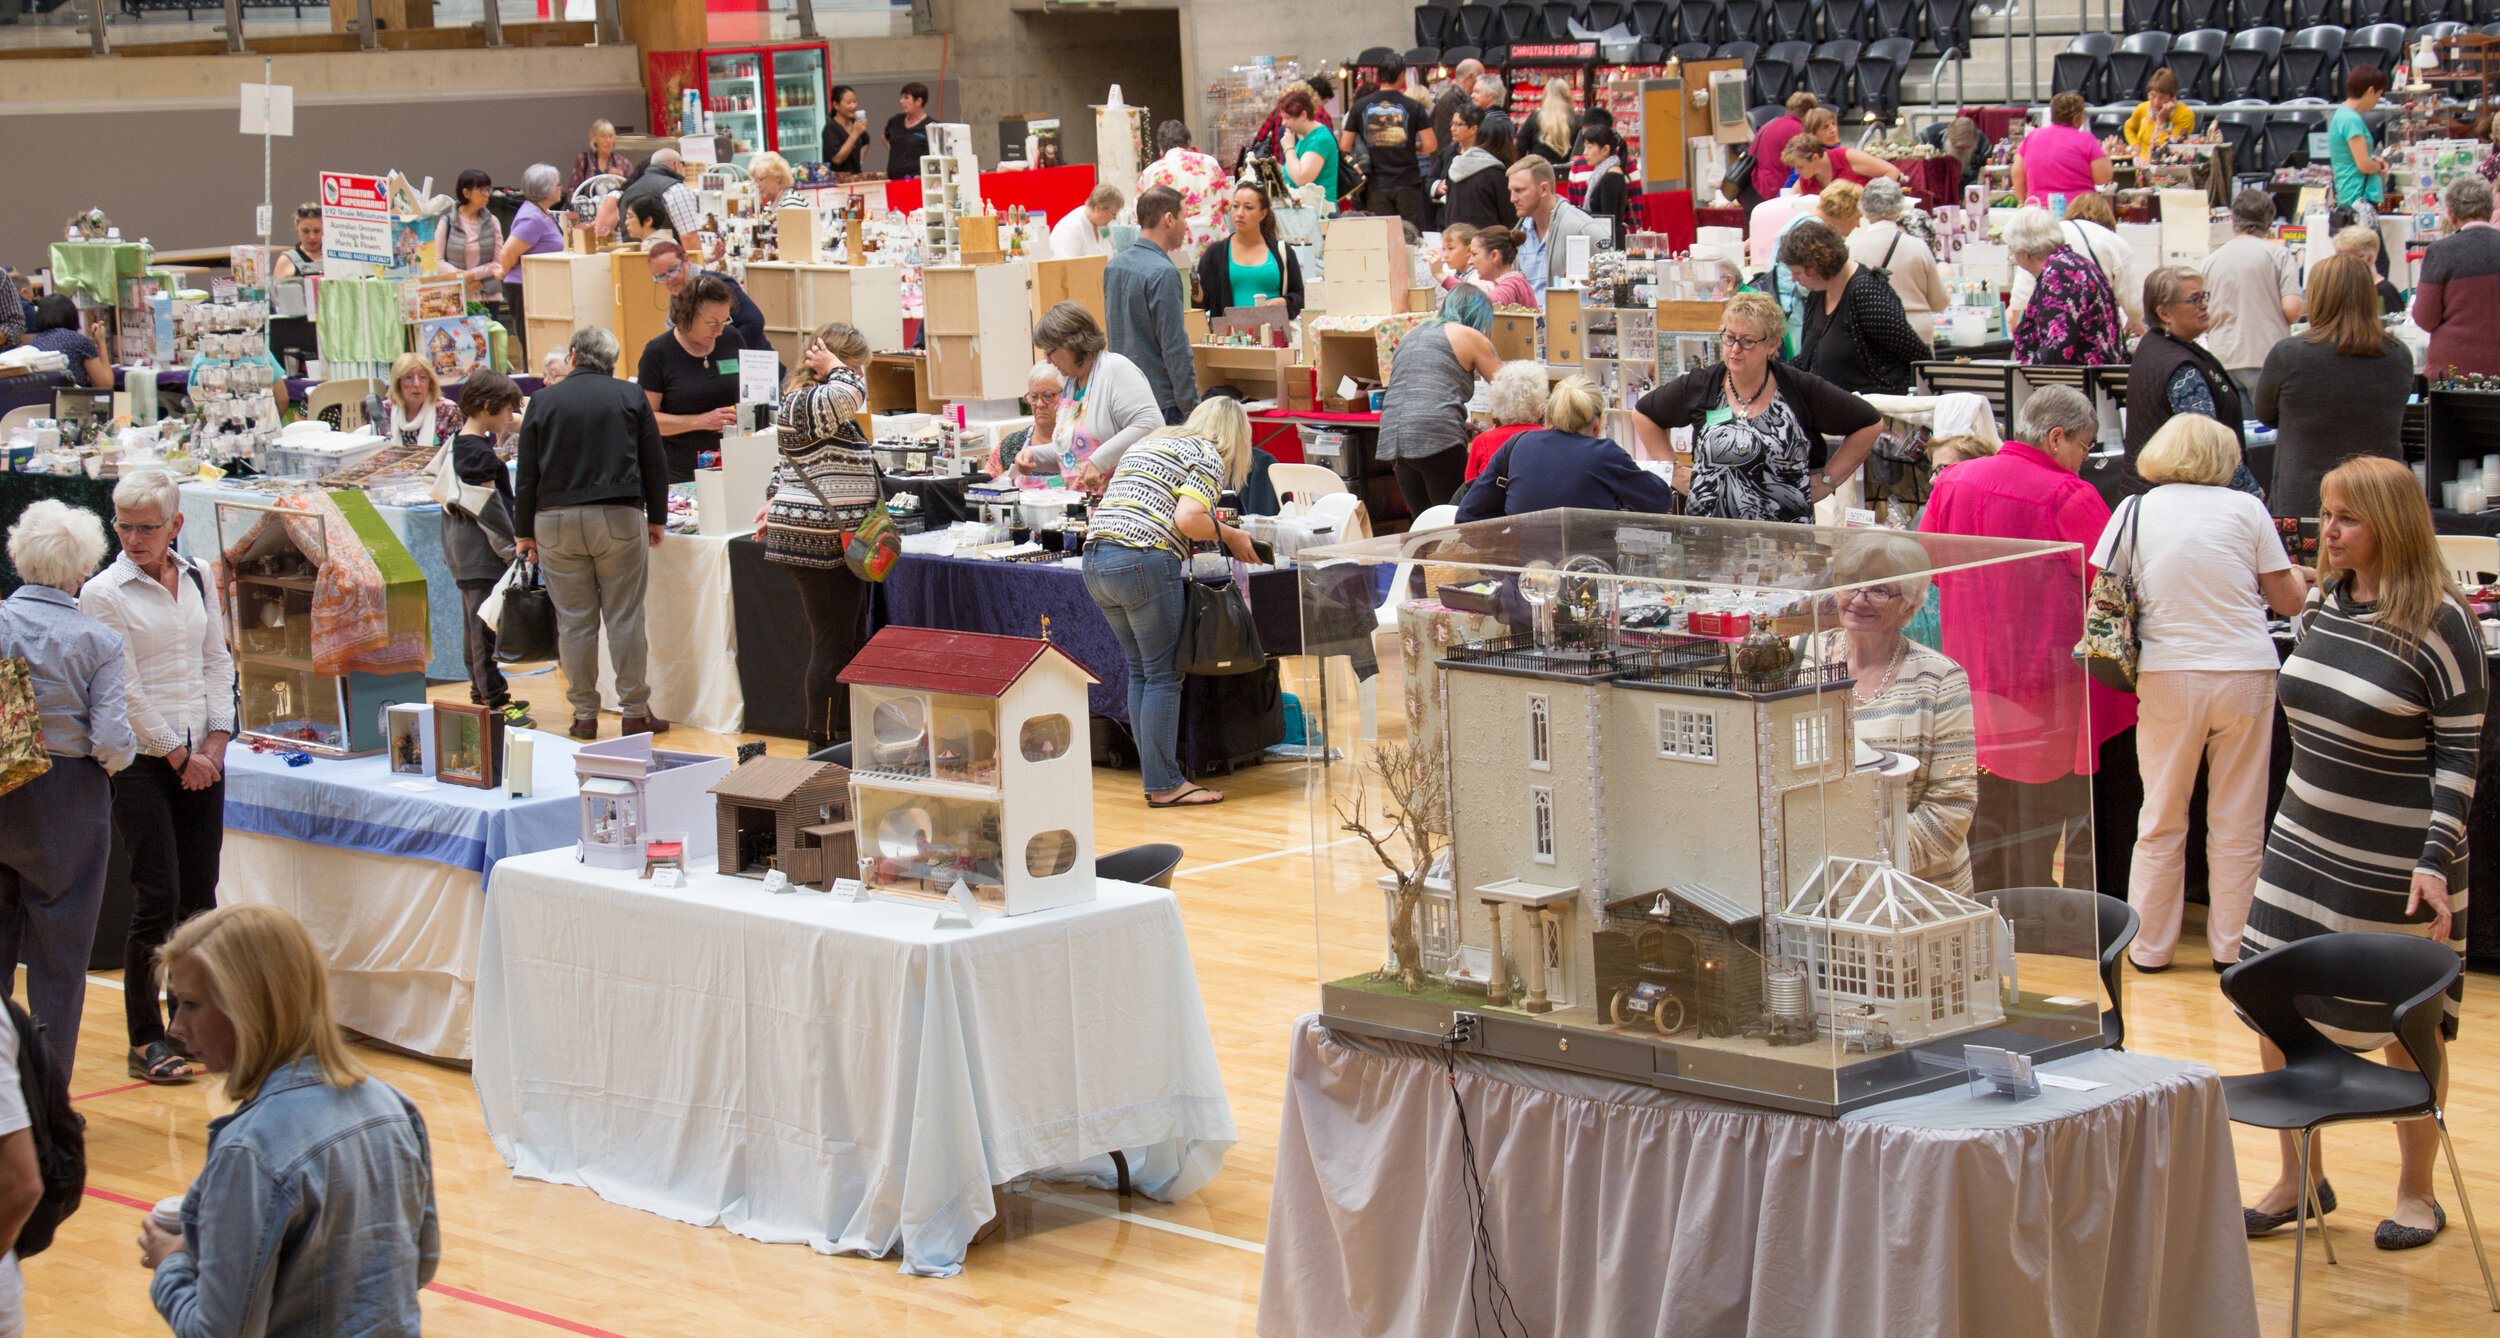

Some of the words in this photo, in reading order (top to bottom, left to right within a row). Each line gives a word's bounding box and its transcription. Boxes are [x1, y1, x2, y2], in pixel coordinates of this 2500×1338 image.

[1512, 45, 1553, 57] CHRISTMAS
[1554, 45, 1579, 56] EVERY
[1579, 45, 1594, 56] DAY
[340, 178, 352, 187] THE
[341, 188, 375, 198] MINIATURE
[341, 198, 386, 209] SUPERMARKET
[325, 207, 336, 215] 1/12
[338, 209, 354, 217] Scale
[356, 210, 387, 220] Miniatures
[331, 222, 357, 230] Australian
[358, 224, 384, 233] Groceries
[339, 231, 358, 241] Vintage
[360, 233, 377, 241] Books
[335, 238, 352, 247] Plants
[360, 242, 380, 250] Flowers
[370, 255, 390, 264] LOCALLY
